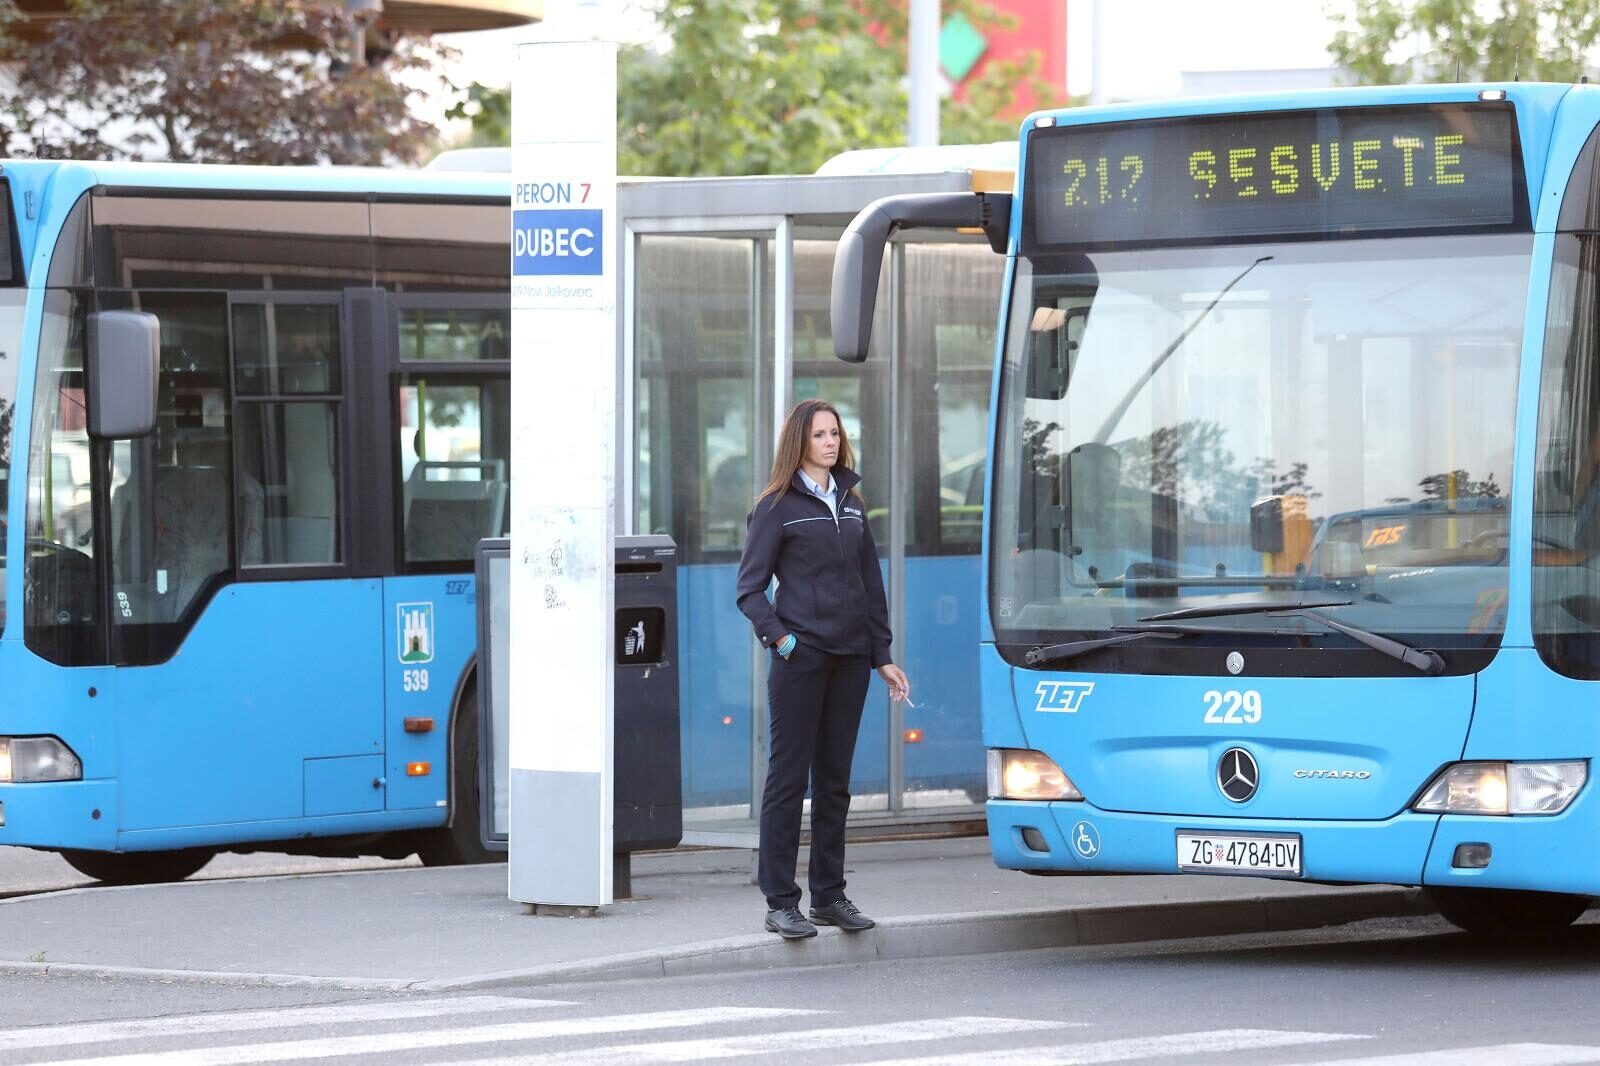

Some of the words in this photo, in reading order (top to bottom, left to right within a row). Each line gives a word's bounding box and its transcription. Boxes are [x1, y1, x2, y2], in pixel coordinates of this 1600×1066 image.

[1063, 155, 1144, 206] 212
[1189, 133, 1465, 199] SESVETE
[516, 182, 571, 204] PERON
[580, 182, 592, 204] 7
[515, 227, 595, 257] DUBEC
[544, 284, 593, 299] Jelkovec
[446, 581, 471, 595] ZET
[117, 591, 132, 617] 539
[403, 669, 429, 692] 539
[1034, 680, 1096, 713] ZET
[1203, 690, 1262, 724] 229
[1293, 769, 1372, 780] CITARO
[1191, 840, 1213, 864] ZG
